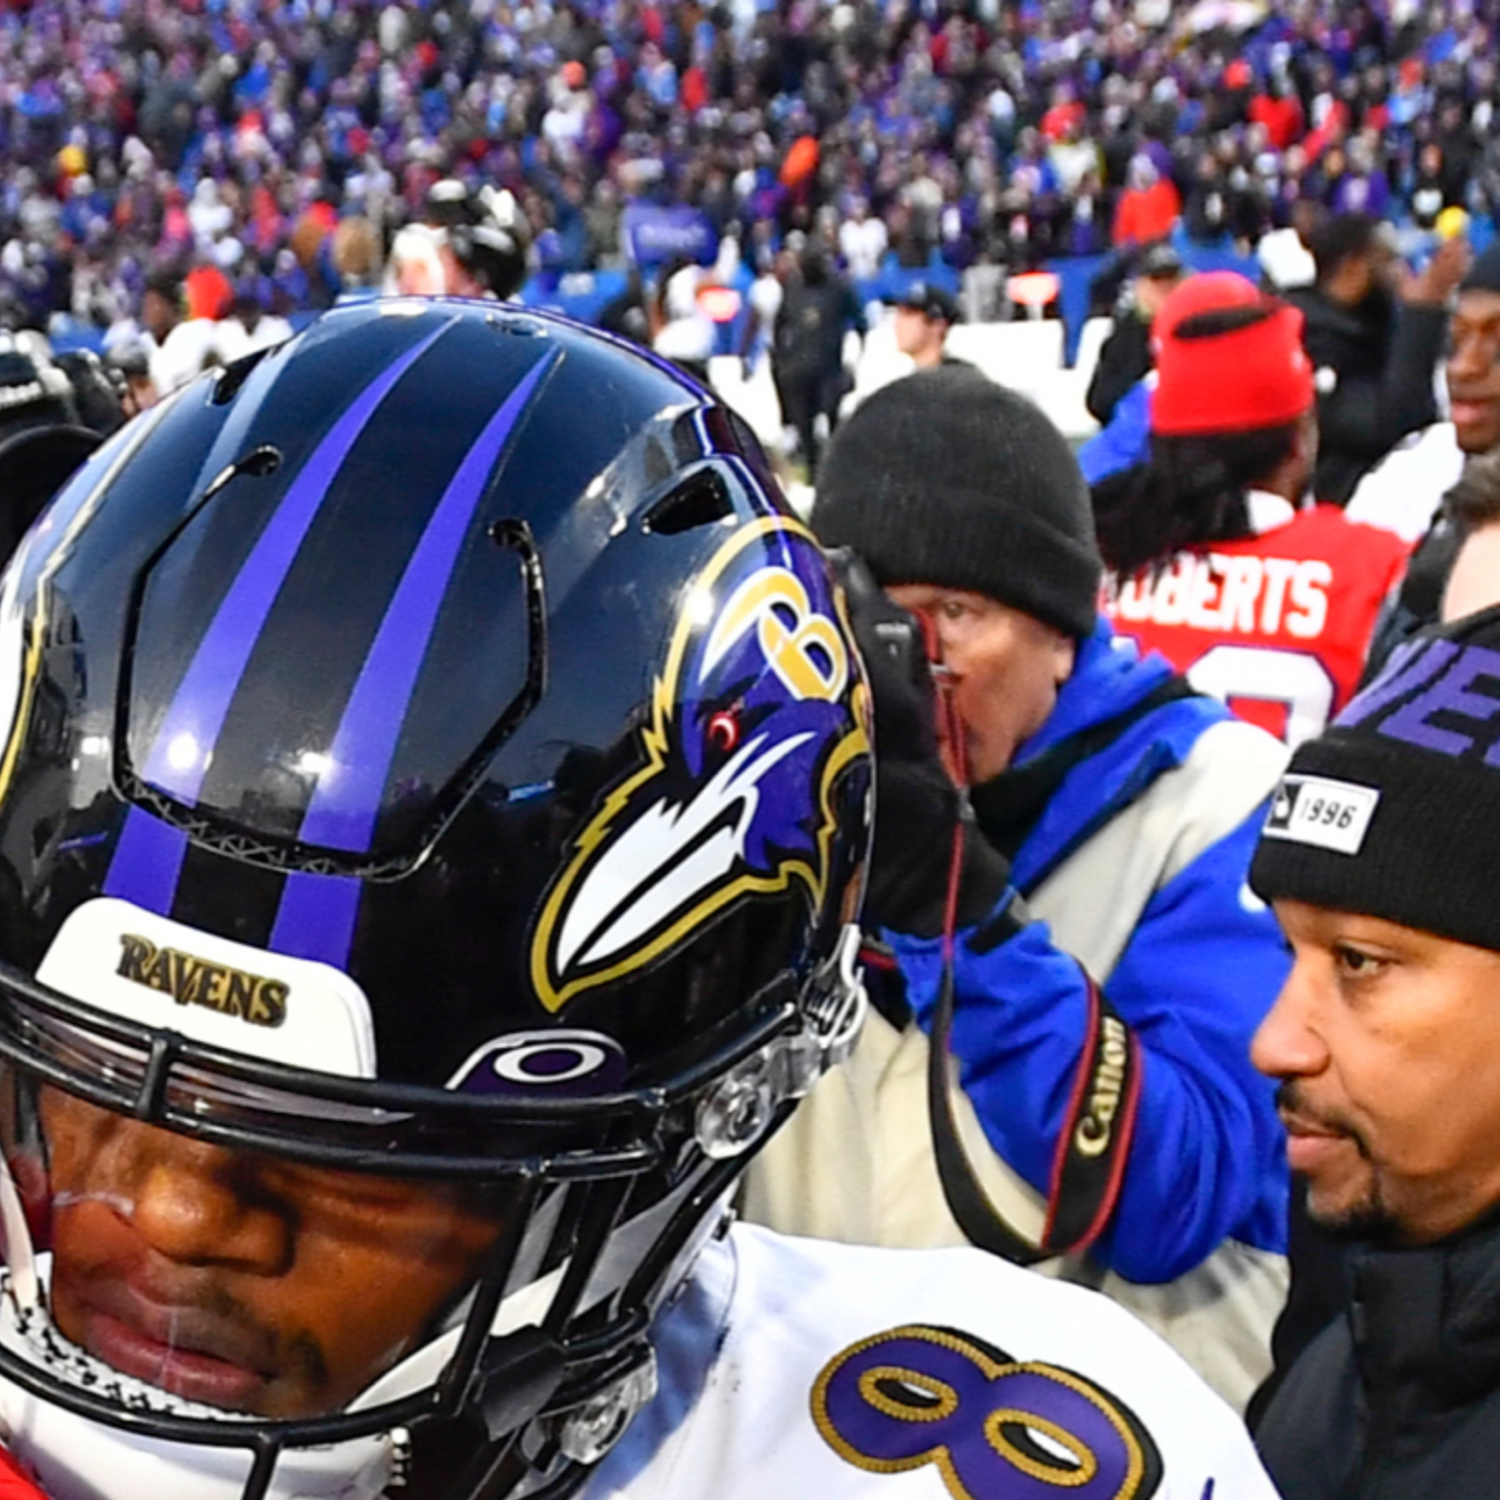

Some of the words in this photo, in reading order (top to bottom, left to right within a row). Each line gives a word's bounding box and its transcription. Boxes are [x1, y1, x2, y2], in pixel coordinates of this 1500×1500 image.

[1330, 634, 1500, 772] VE
[1298, 797, 1358, 830] 1996
[115, 932, 291, 1030] RAVENS
[1075, 1015, 1127, 1158] Canon
